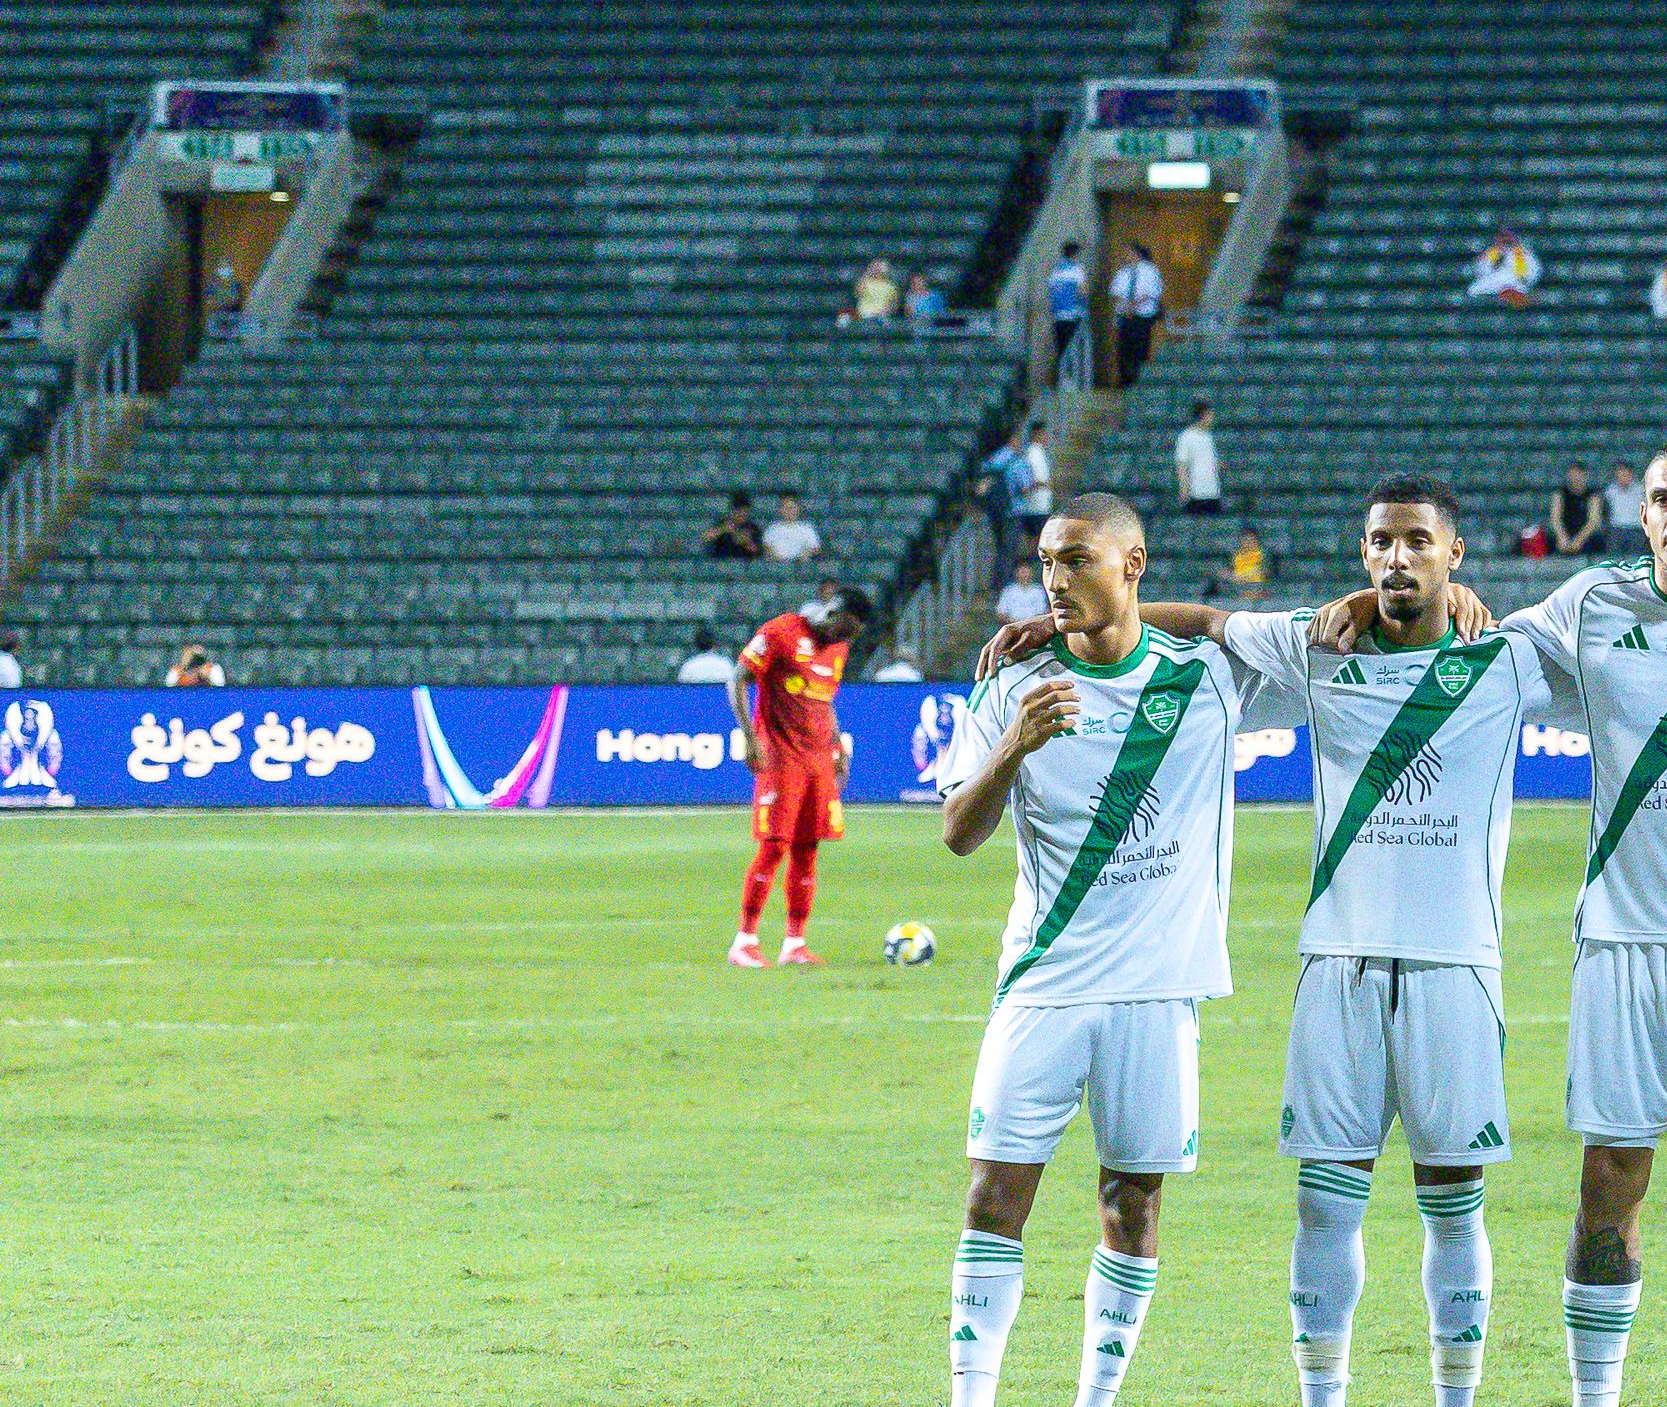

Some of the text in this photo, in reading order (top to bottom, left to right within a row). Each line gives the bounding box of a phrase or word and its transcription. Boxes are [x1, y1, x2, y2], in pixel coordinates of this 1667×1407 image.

[1376, 677, 1400, 685] SIRC
[1081, 727, 1107, 736] SIRC
[127, 711, 376, 783] هونغ كونغ
[596, 728, 724, 770] Hong
[1377, 831, 1404, 845] Sea
[1408, 832, 1457, 847] Global
[1111, 870, 1138, 887] Sea
[1139, 865, 1177, 881] Glob
[1452, 1290, 1486, 1303] AHL
[1100, 1308, 1138, 1325] AHLI
